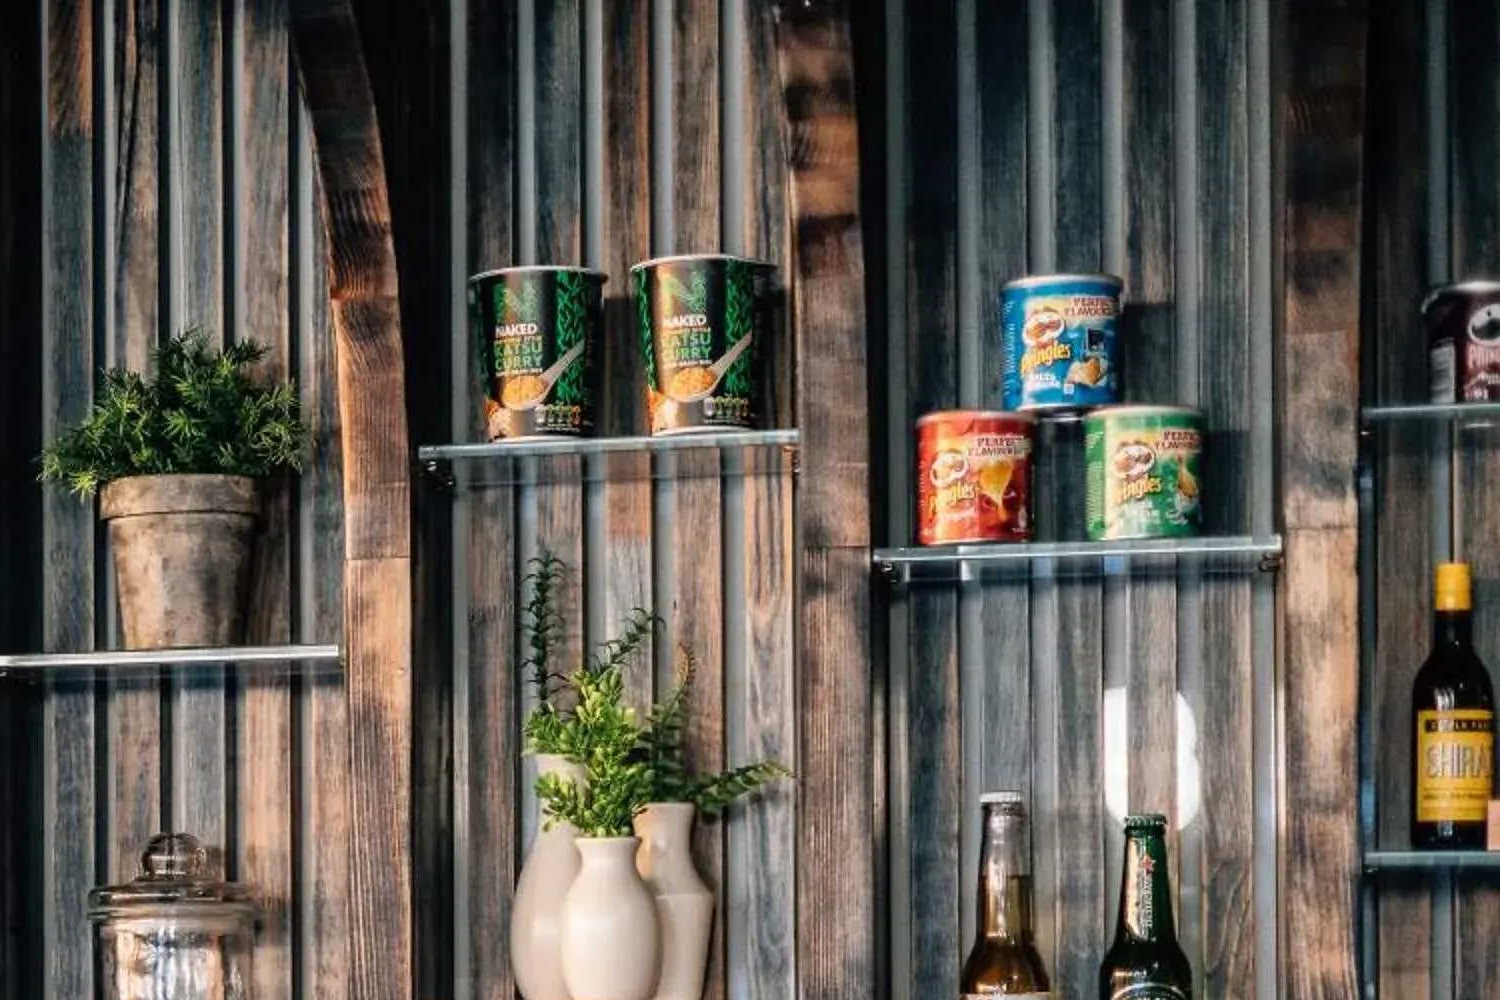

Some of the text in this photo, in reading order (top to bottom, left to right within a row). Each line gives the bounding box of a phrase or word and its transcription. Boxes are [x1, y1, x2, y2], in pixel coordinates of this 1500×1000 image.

[663, 315, 707, 328] NAKED
[495, 324, 538, 337] NAKED
[1427, 743, 1492, 779] SHIRA
